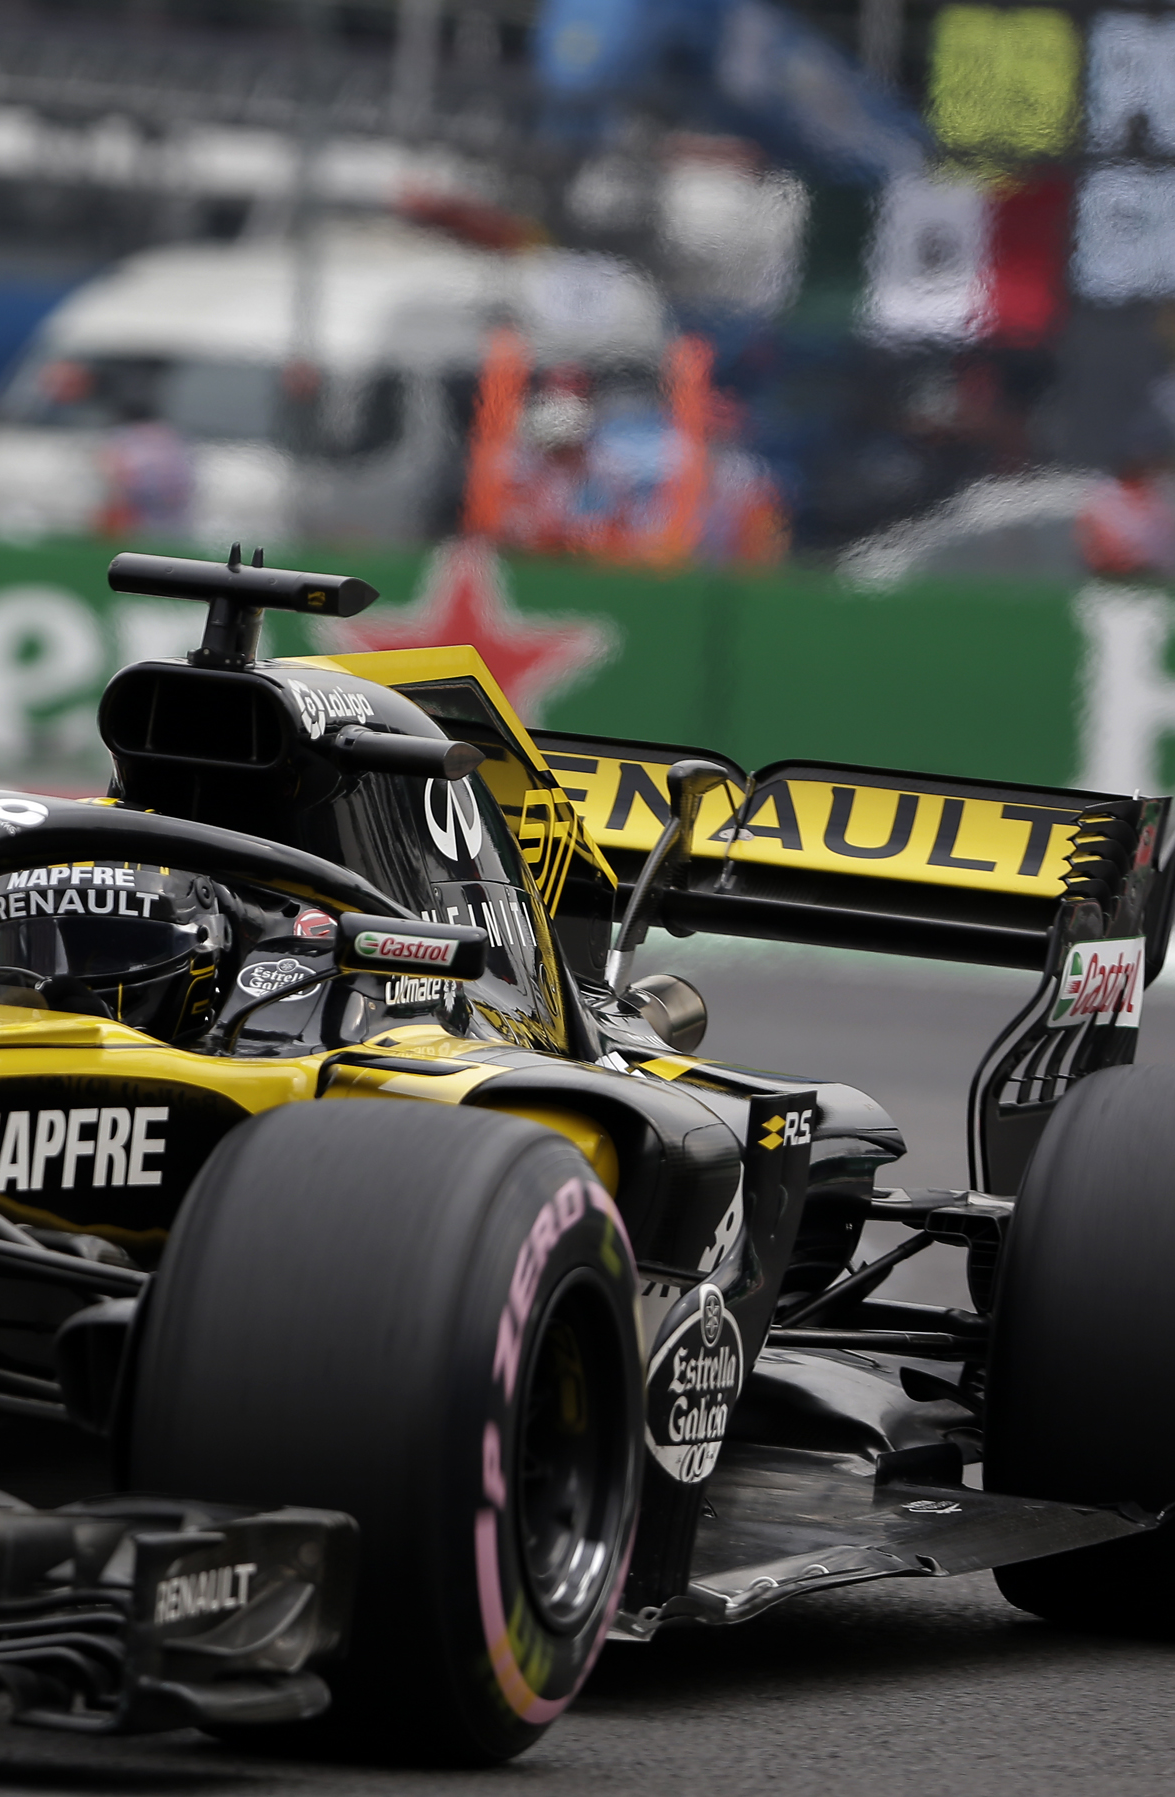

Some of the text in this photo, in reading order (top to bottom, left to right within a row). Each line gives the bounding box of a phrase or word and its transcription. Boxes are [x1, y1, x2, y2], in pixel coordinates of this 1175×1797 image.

[317, 686, 374, 724] LaLiga
[542, 753, 1087, 880] ENAULT
[6, 866, 135, 890] MAPFRE
[379, 937, 451, 962] Castrol
[491, 1177, 586, 1407] ZERO
[667, 1346, 737, 1393] Estrella
[668, 1392, 728, 1442] Galicia
[154, 1562, 257, 1626] RENAULT
